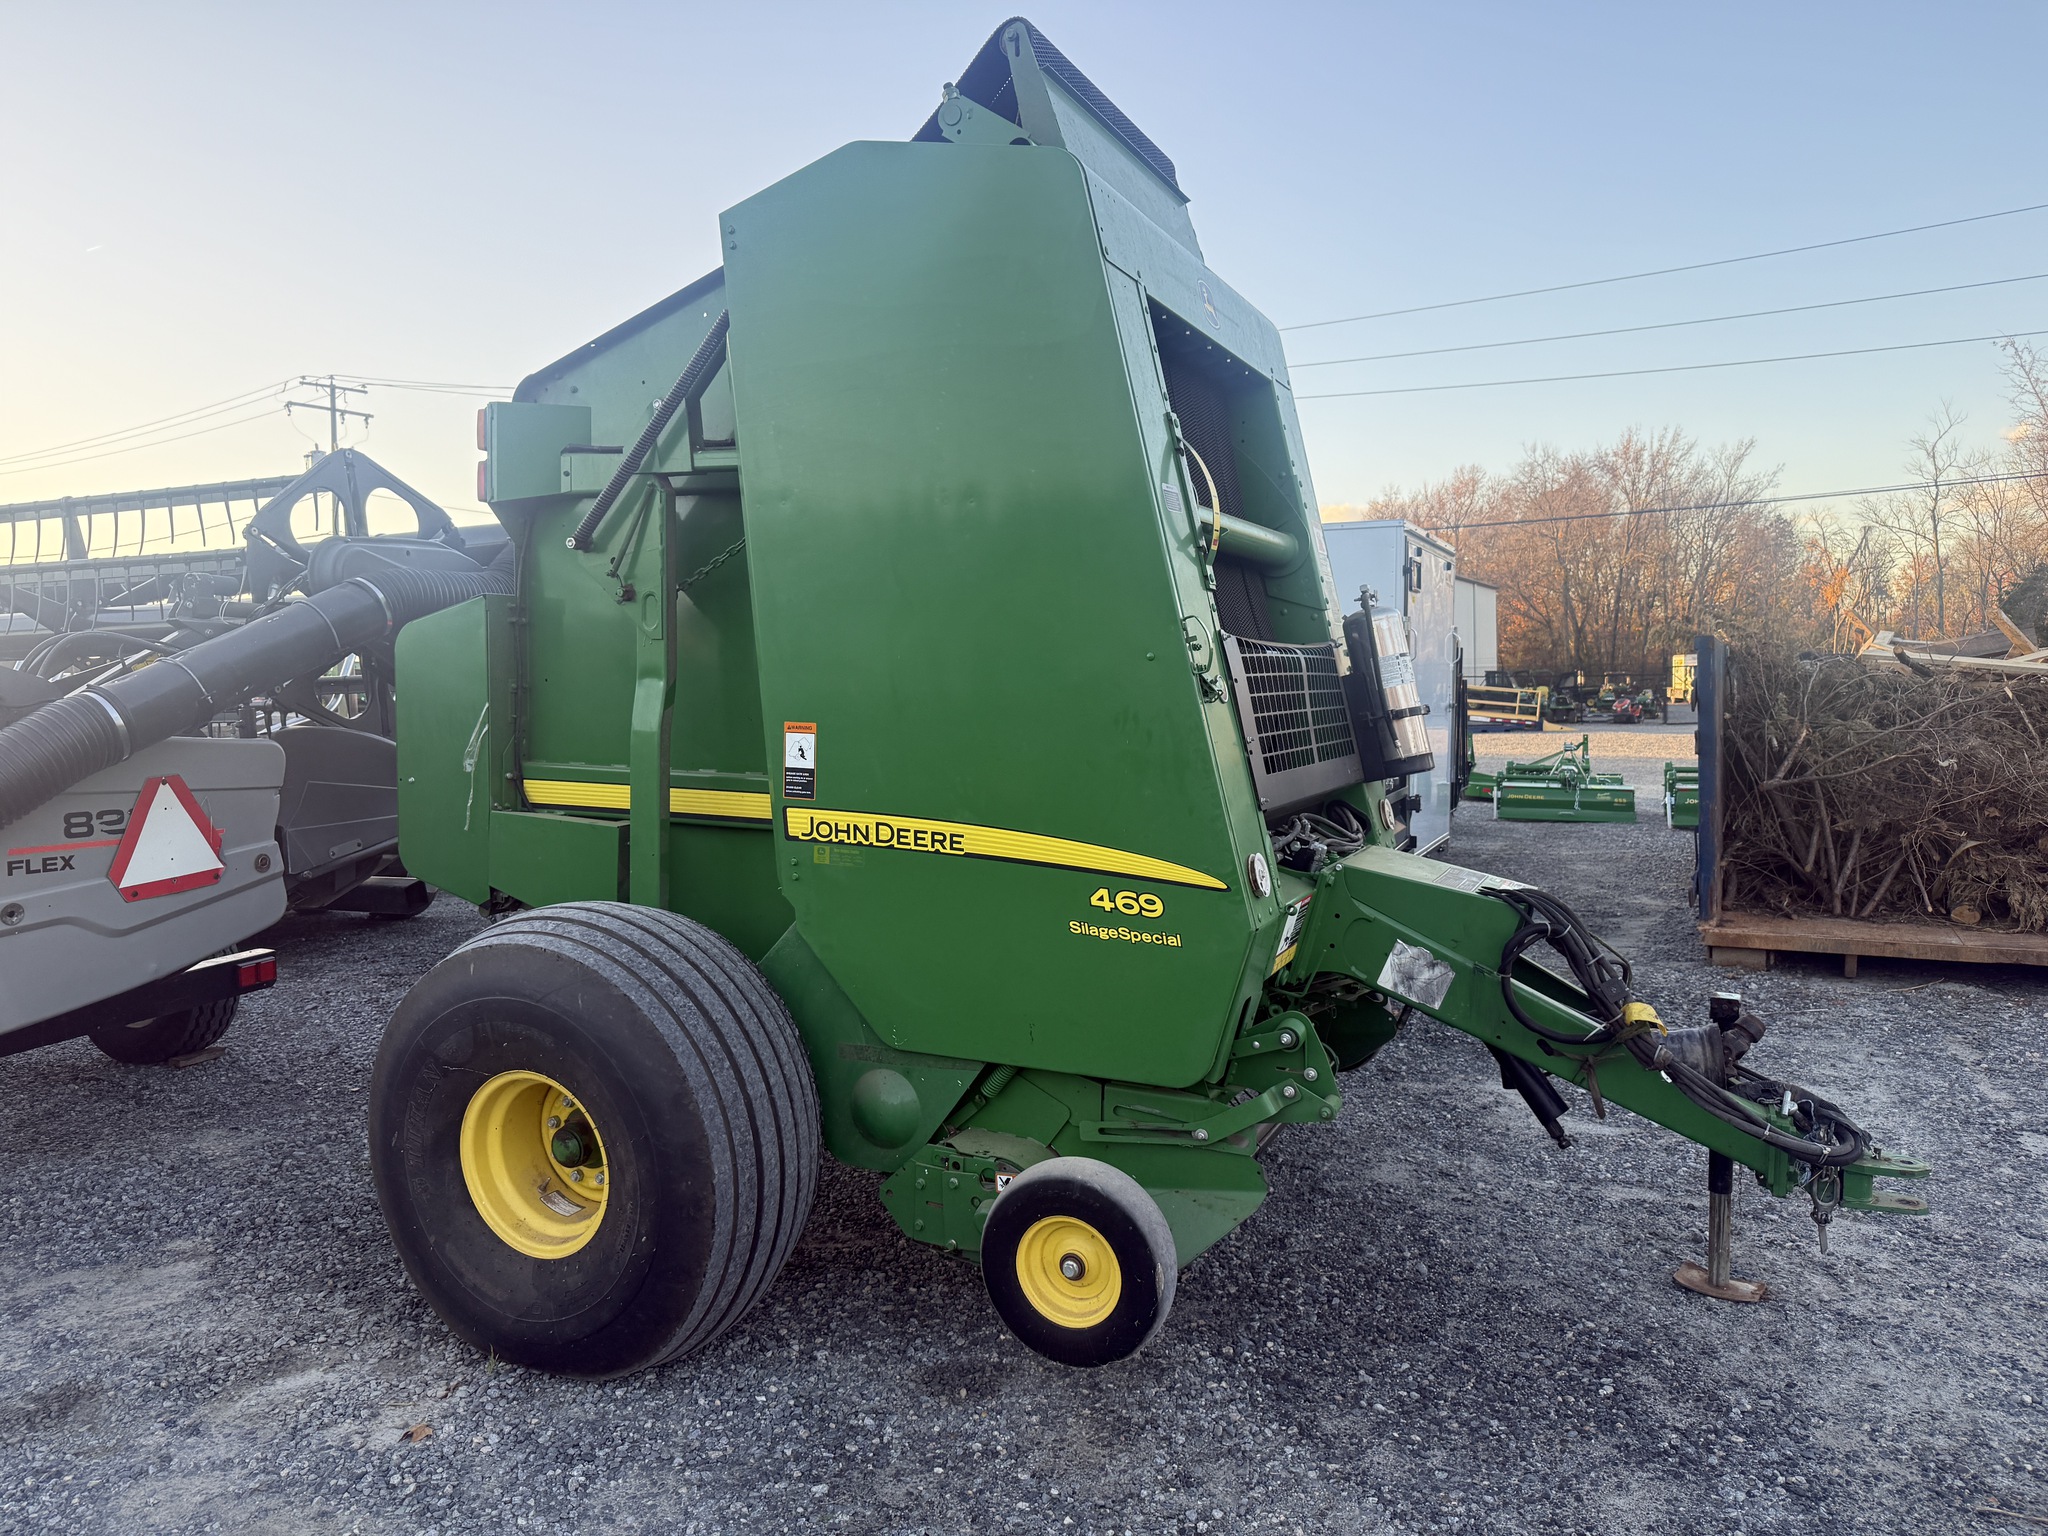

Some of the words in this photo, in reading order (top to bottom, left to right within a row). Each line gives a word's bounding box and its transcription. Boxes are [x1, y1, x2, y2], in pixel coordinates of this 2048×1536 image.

[63, 809, 134, 839] 82
[801, 816, 870, 843] JOHN
[875, 821, 965, 852] DEERE
[7, 855, 75, 876] FLEX
[1089, 887, 1165, 918] 469
[1068, 920, 1183, 948] SilageSpecial
